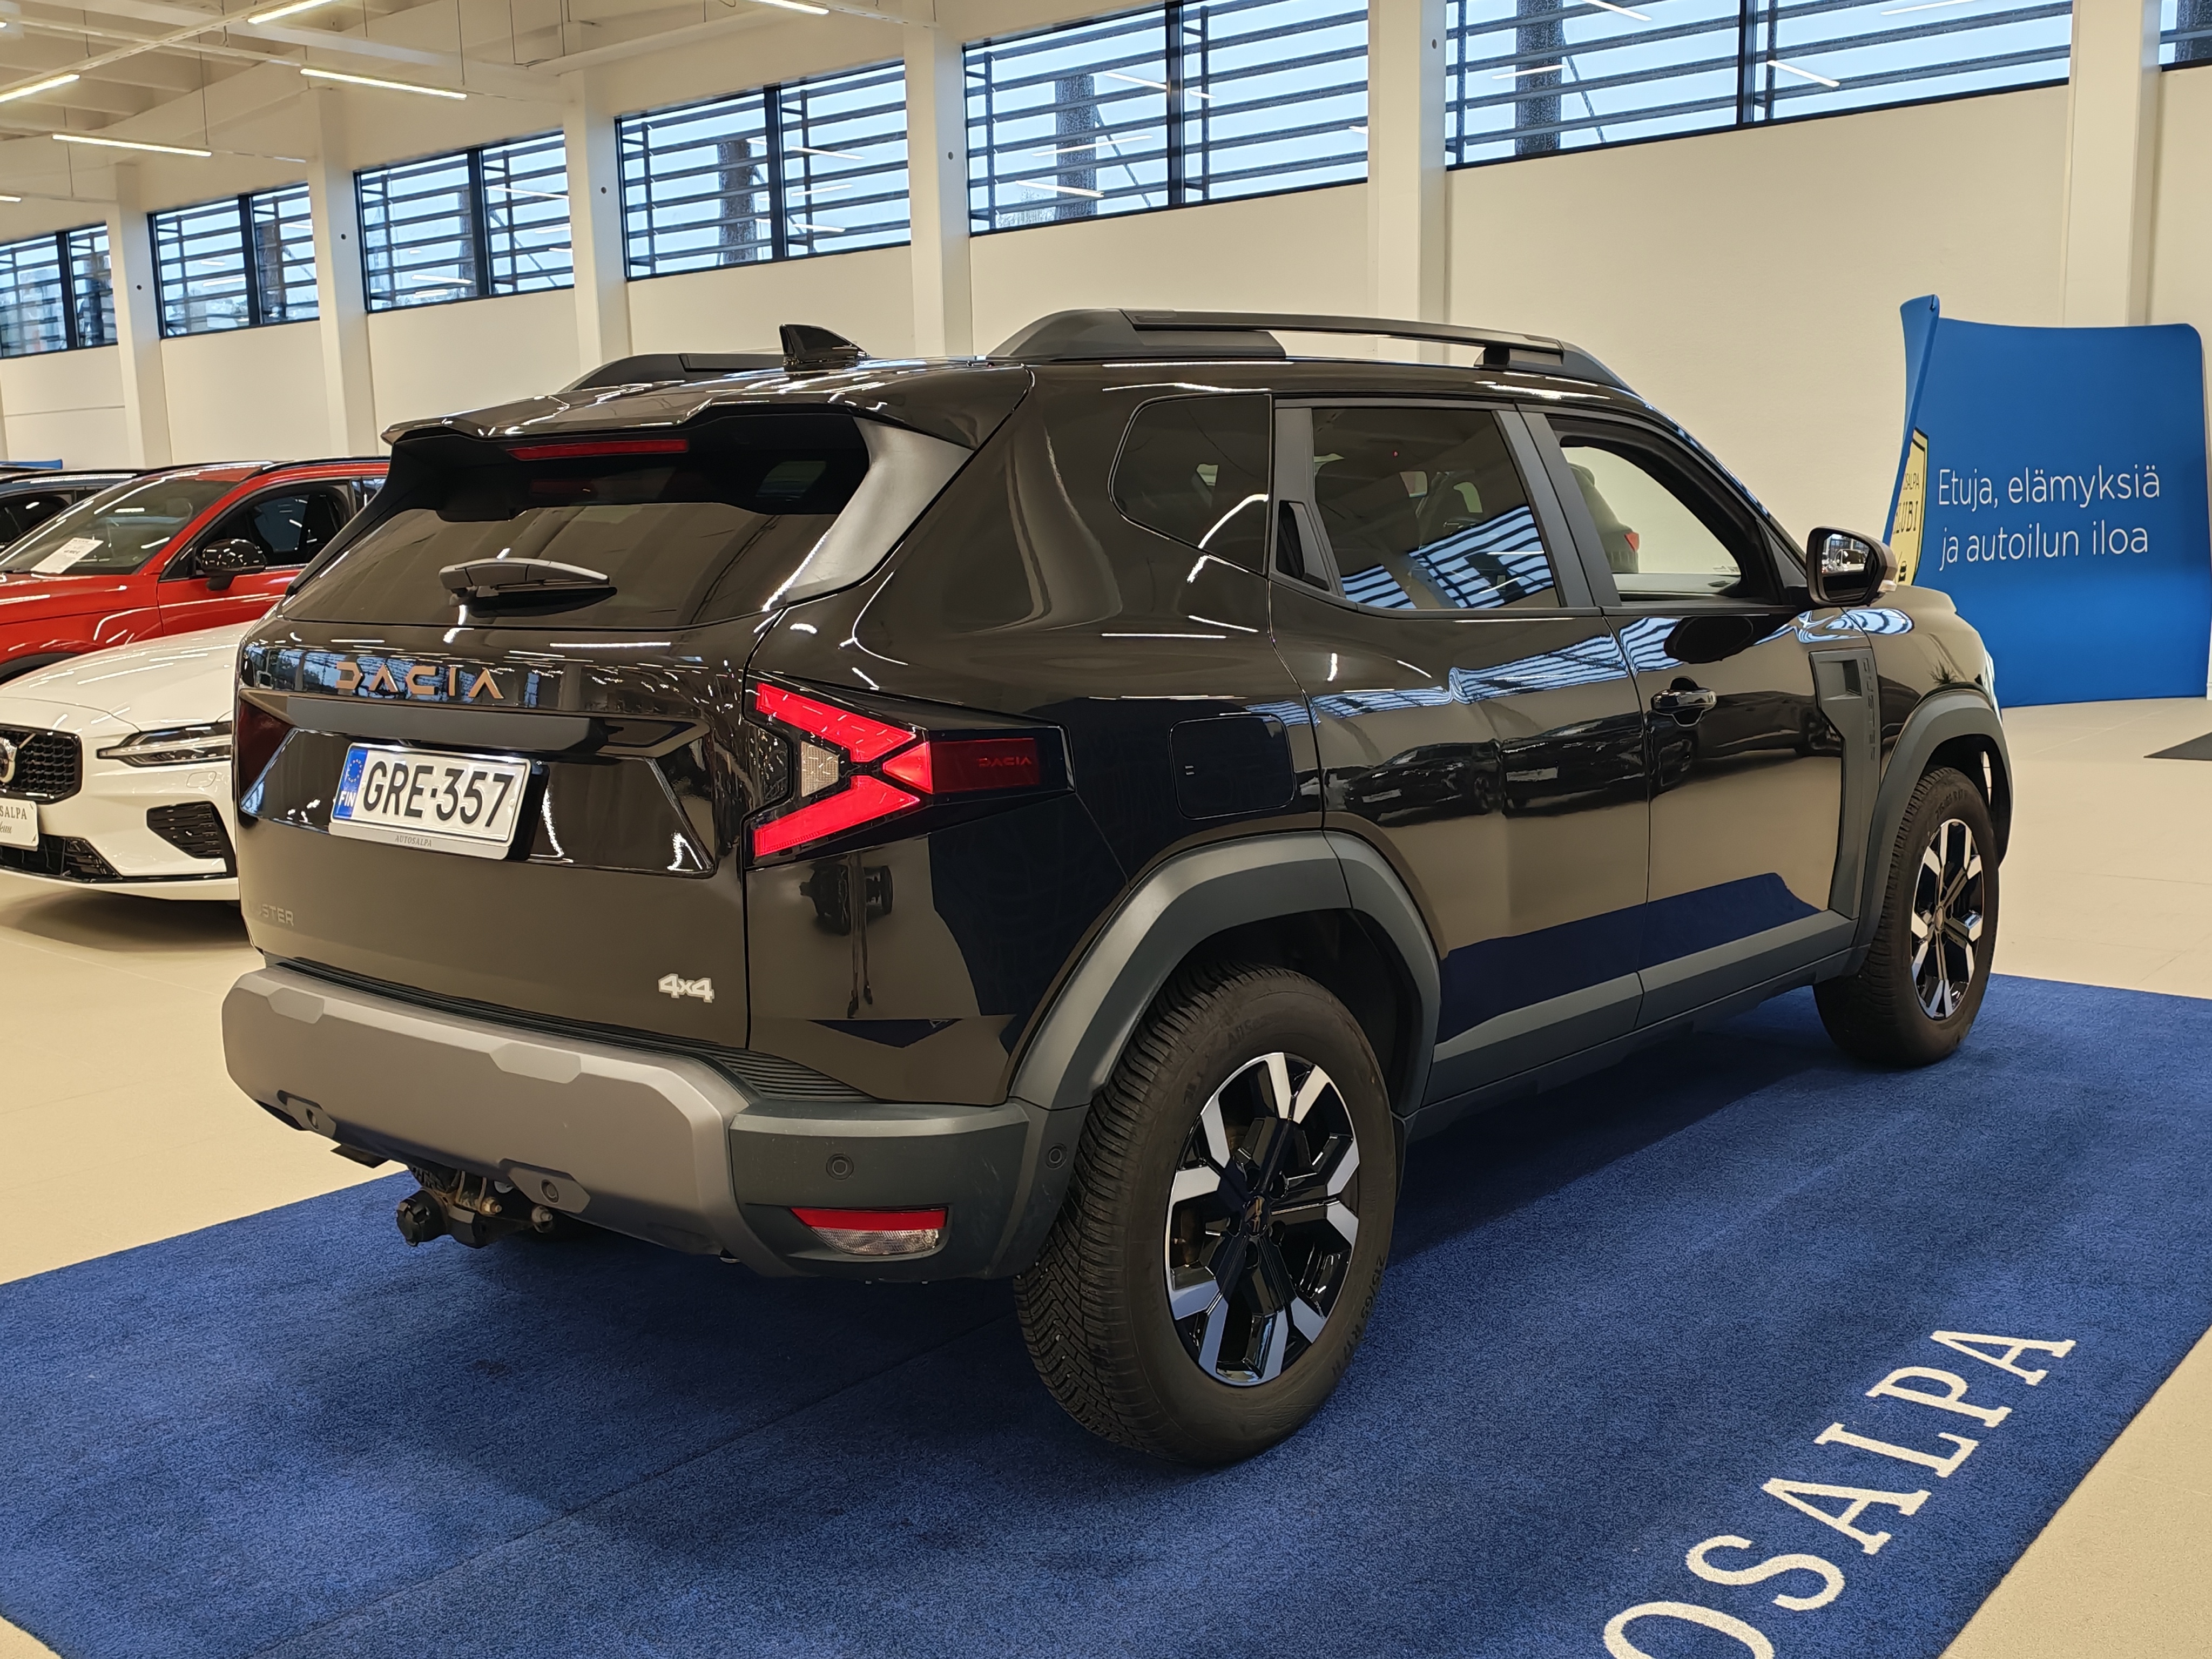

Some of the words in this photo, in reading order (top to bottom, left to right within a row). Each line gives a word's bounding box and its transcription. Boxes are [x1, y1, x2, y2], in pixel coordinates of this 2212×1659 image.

[1939, 468, 1998, 512] Etuja,
[2008, 464, 2160, 508] elämyksiä
[1939, 528, 1958, 571] ja
[1966, 523, 2079, 562] autoilun
[2093, 520, 2148, 556] iloa
[335, 661, 504, 699] DACIA
[979, 756, 1032, 767] DACIA
[338, 791, 356, 807] FIN
[363, 760, 515, 828] GRE-357
[395, 835, 431, 847] AUTOSALPA
[658, 973, 715, 1003] 4x4
